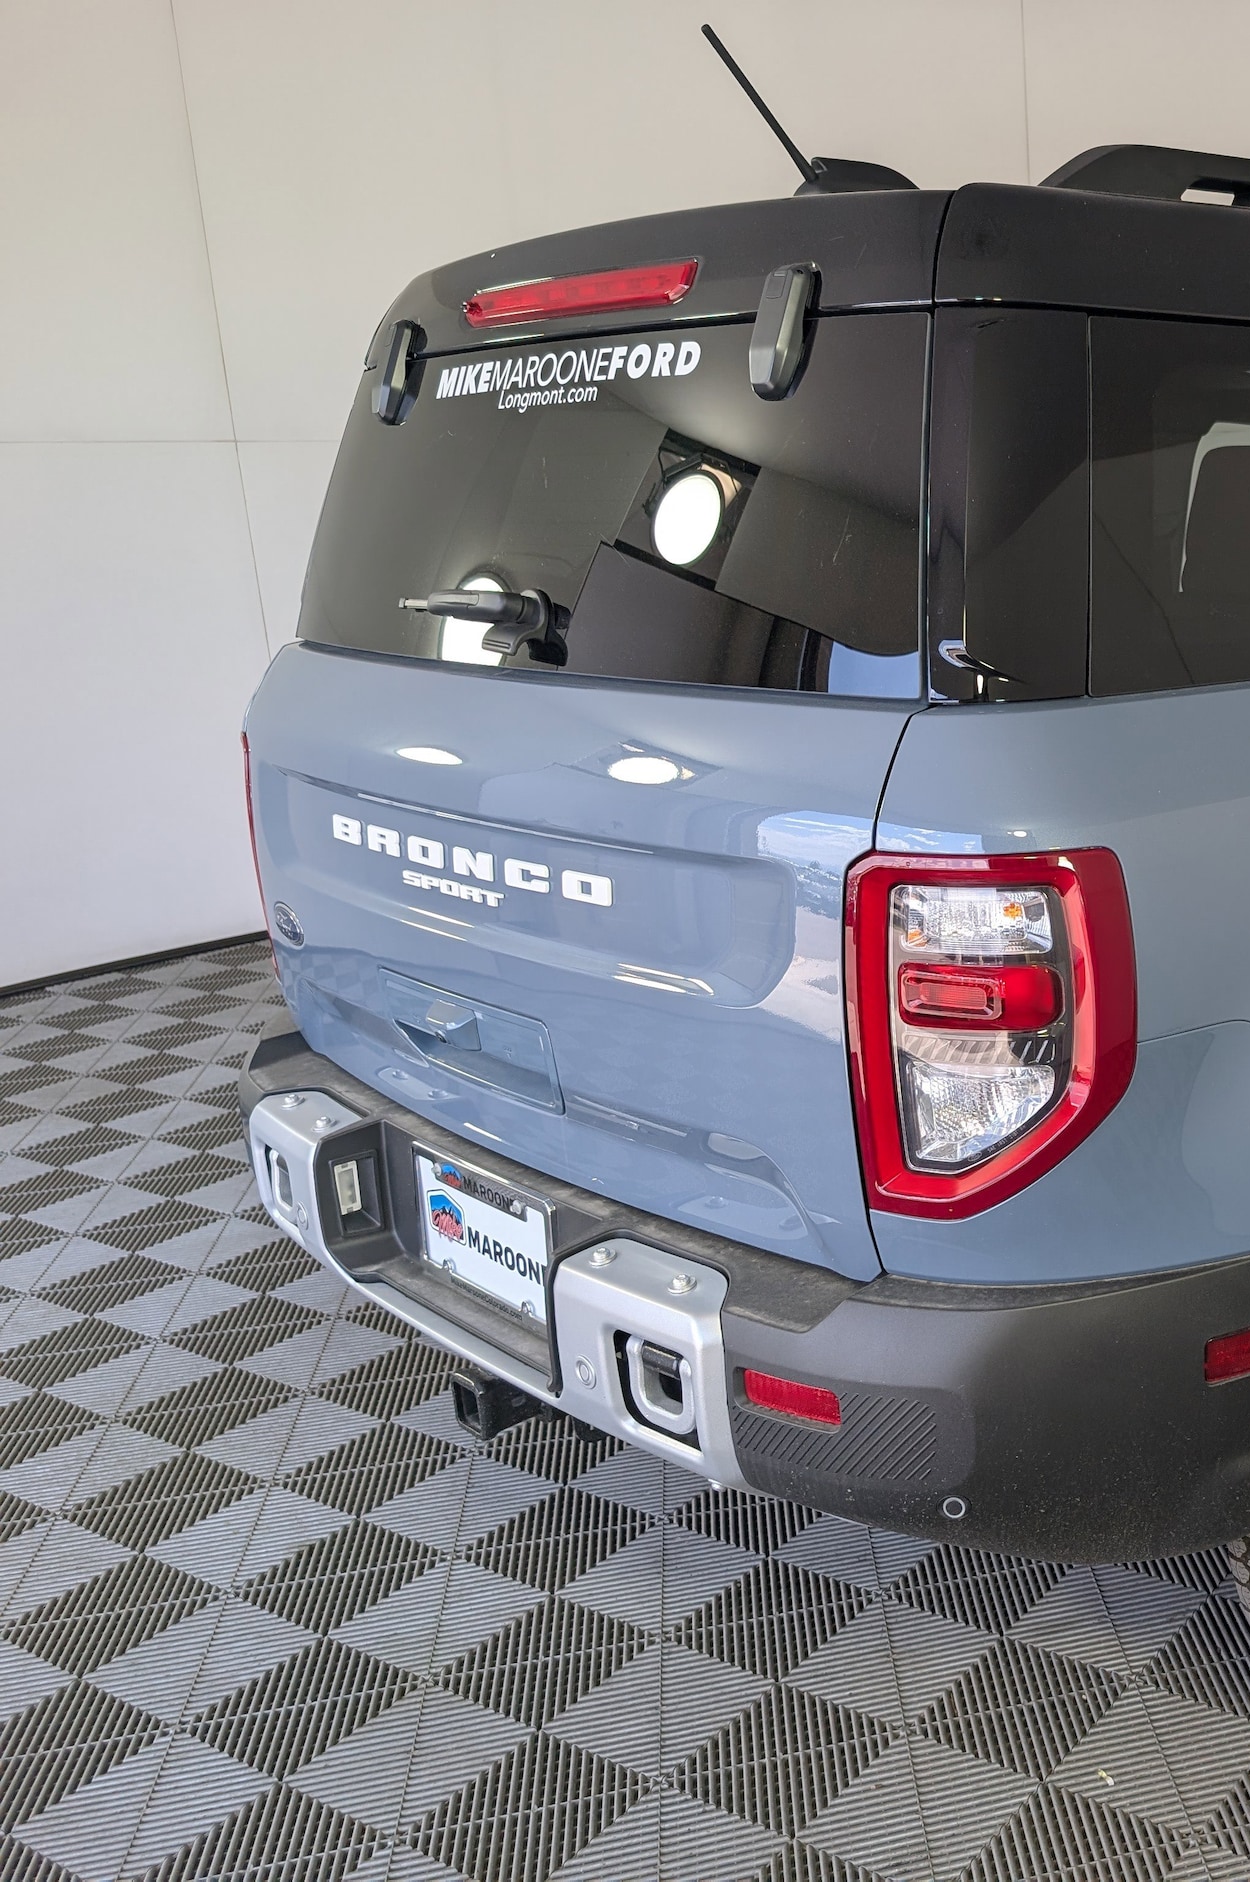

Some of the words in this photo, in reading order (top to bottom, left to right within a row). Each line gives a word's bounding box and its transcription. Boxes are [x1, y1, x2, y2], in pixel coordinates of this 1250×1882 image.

[497, 385, 598, 413] Longmont.com
[332, 813, 614, 907] BRONCO
[402, 869, 505, 907] SPORT
